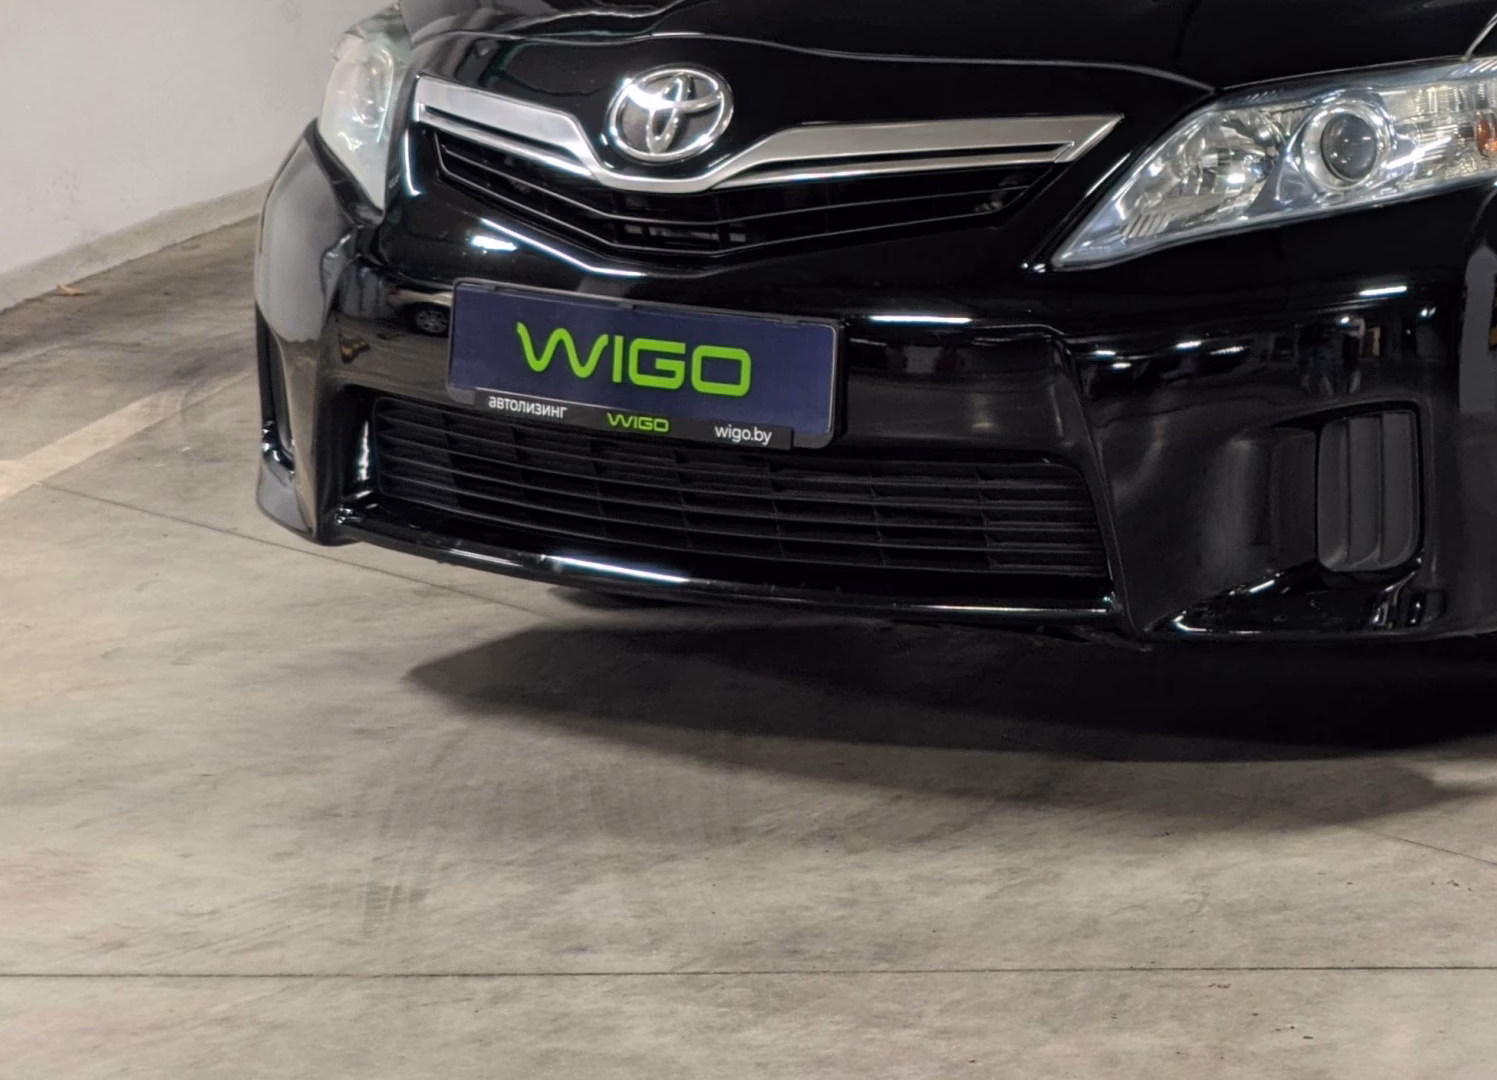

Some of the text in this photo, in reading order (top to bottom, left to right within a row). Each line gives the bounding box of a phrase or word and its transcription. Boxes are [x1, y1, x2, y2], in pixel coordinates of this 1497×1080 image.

[515, 321, 752, 397] WIGO
[488, 395, 568, 419] автолизинг
[607, 413, 670, 433] WIGO
[714, 424, 773, 446] wigo.by
